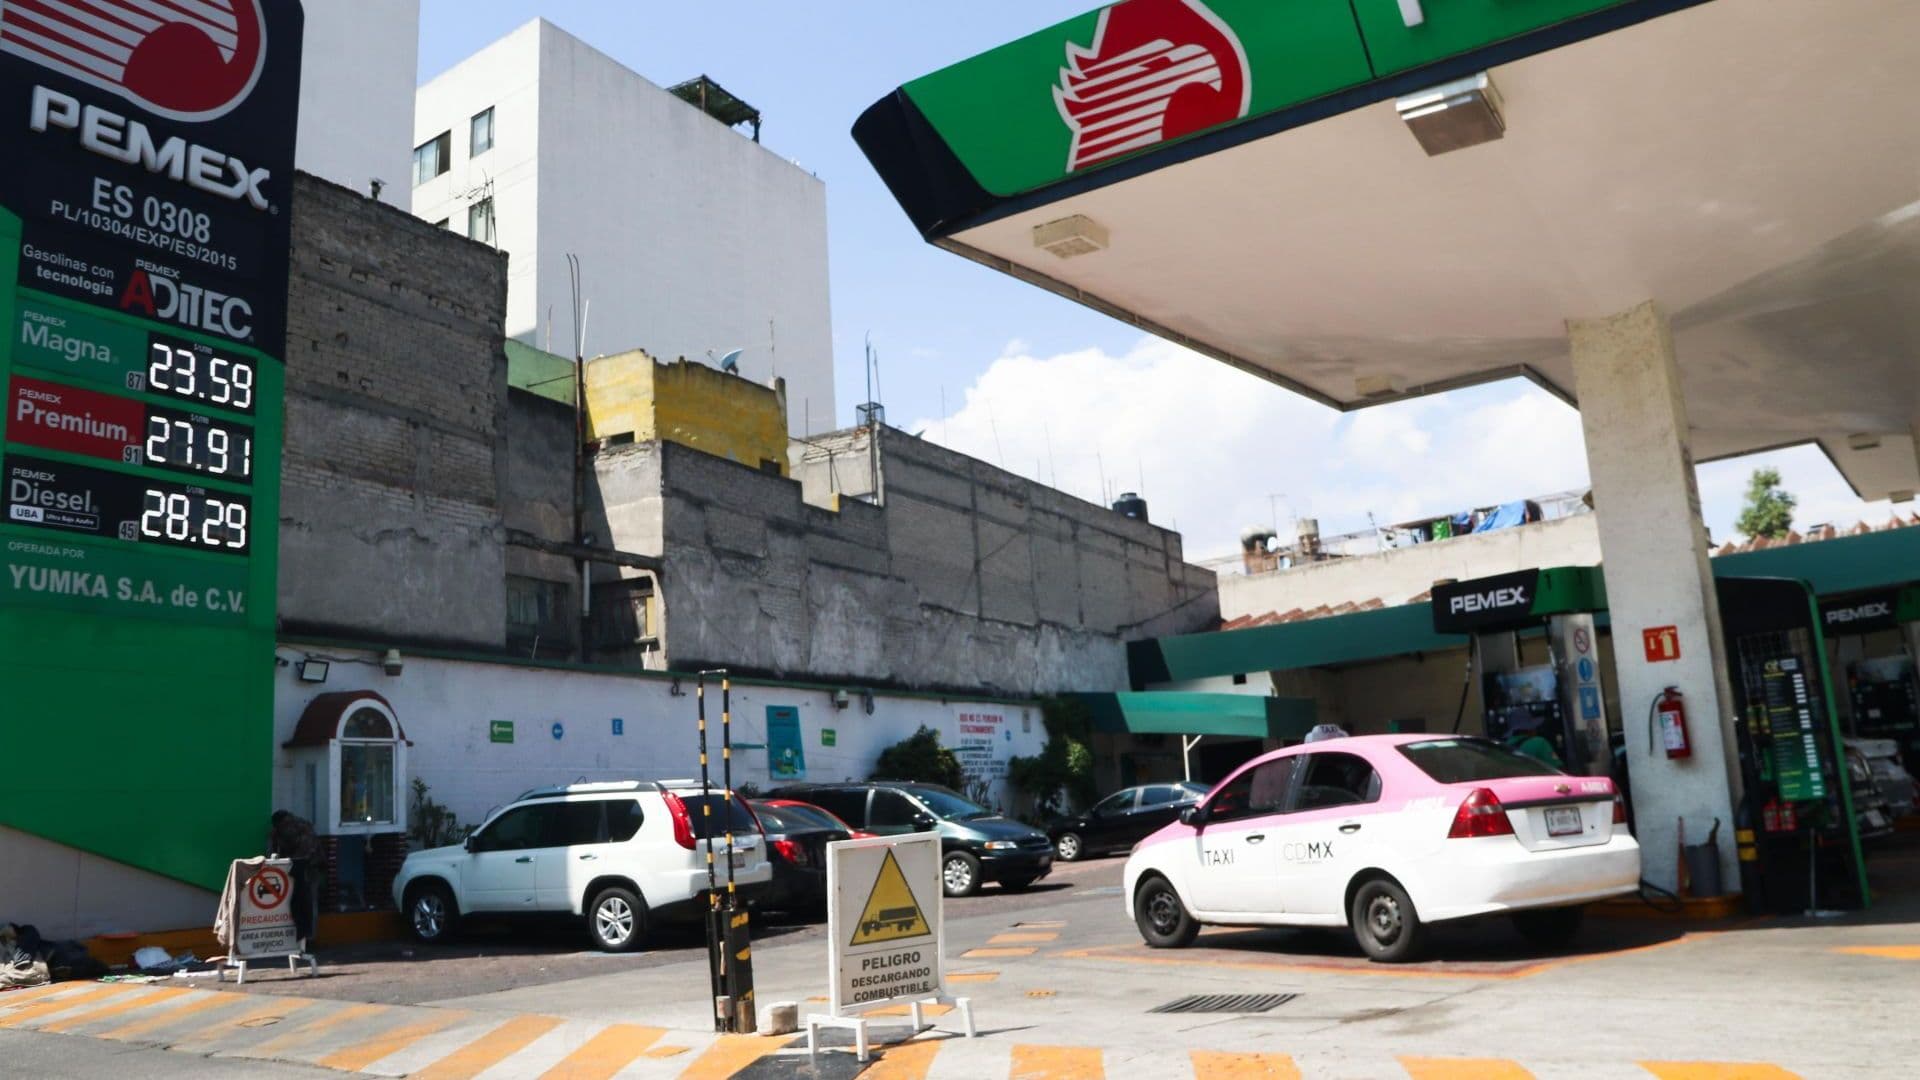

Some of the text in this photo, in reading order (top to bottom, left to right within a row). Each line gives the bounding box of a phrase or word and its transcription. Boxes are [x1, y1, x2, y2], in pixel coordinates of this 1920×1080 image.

[29, 84, 271, 211] PEMEX
[92, 176, 211, 243] ES 0308
[51, 200, 237, 270] PL/10304/EXP/ES/2015
[23, 244, 114, 280] Gasolinas con
[135, 259, 180, 279] PEMEX
[36, 265, 114, 296] tecnología
[23, 310, 66, 328] PEMEX
[22, 321, 111, 363] Magna
[150, 343, 252, 408] 23.59
[19, 388, 62, 404] PEMEX
[16, 399, 127, 442] Premium
[147, 416, 250, 476] 27.91
[12, 467, 56, 482] PEMEX
[10, 478, 91, 513] Diesel
[16, 508, 39, 519] UBA
[141, 489, 246, 548] 28.29
[8, 541, 85, 559] OPERADA POR
[8, 563, 244, 613] YUMKA S.A. de C.V.
[1450, 586, 1526, 614] PEMEX
[1826, 602, 1889, 624] PEMEX
[1204, 841, 1334, 866] TAXI CDMX
[862, 951, 921, 971] PELIGRO
[851, 967, 931, 988] DESCARGANDO
[854, 981, 930, 1002] COMBUSTIBLE
